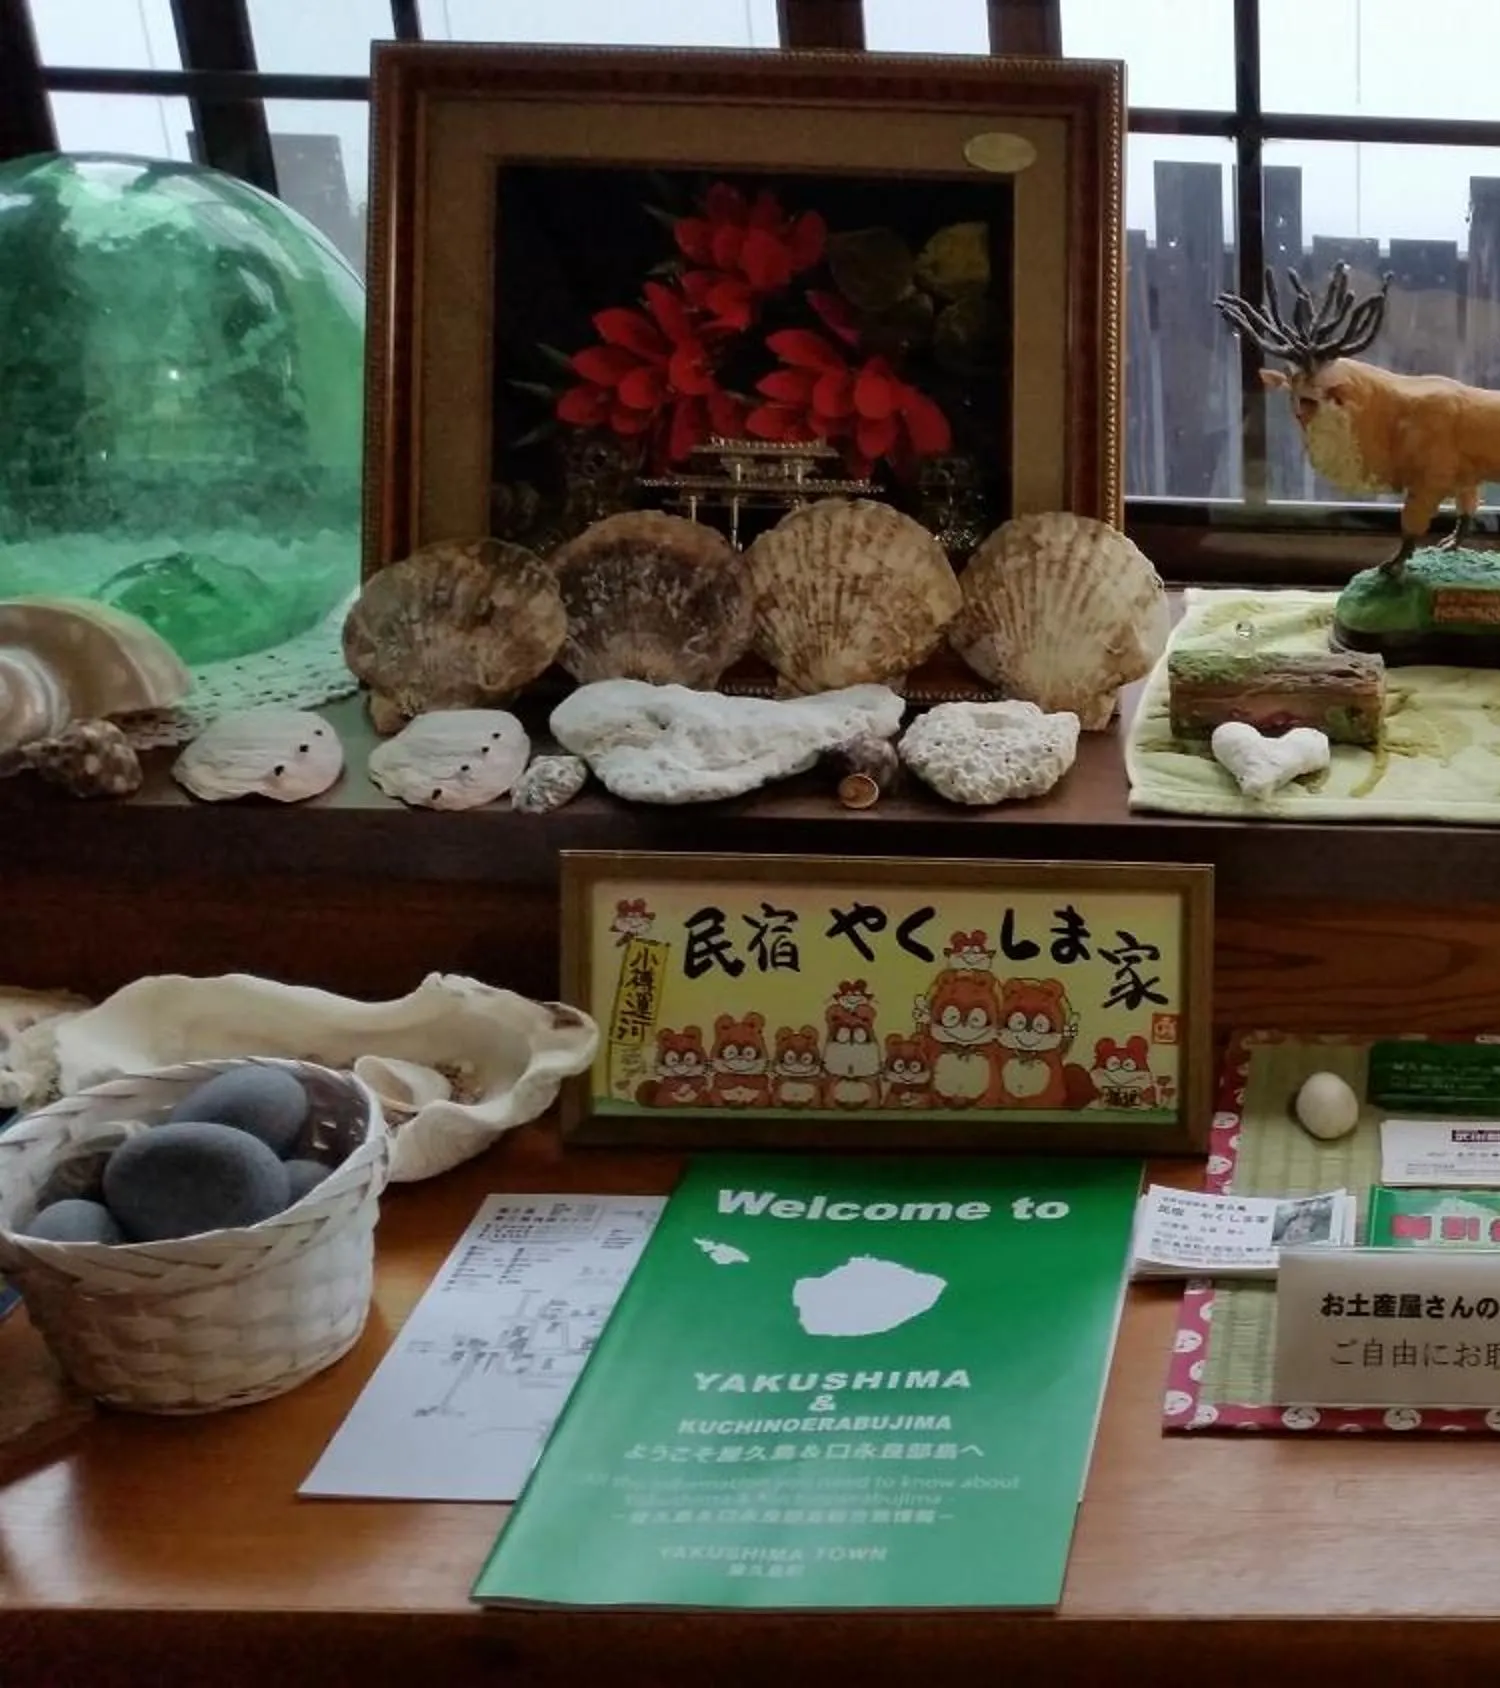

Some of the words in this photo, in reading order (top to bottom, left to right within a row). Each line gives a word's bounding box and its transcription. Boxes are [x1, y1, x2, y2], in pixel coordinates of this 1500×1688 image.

[717, 1189, 992, 1222] Welcome
[1011, 1196, 1071, 1222] to
[693, 1368, 973, 1394] YAKUSHIMA
[808, 1393, 838, 1412] &
[677, 1414, 953, 1436] KUCHINOERABUJIMA
[873, 1474, 896, 1489] to
[899, 1474, 957, 1489] know
[959, 1473, 1021, 1489] about
